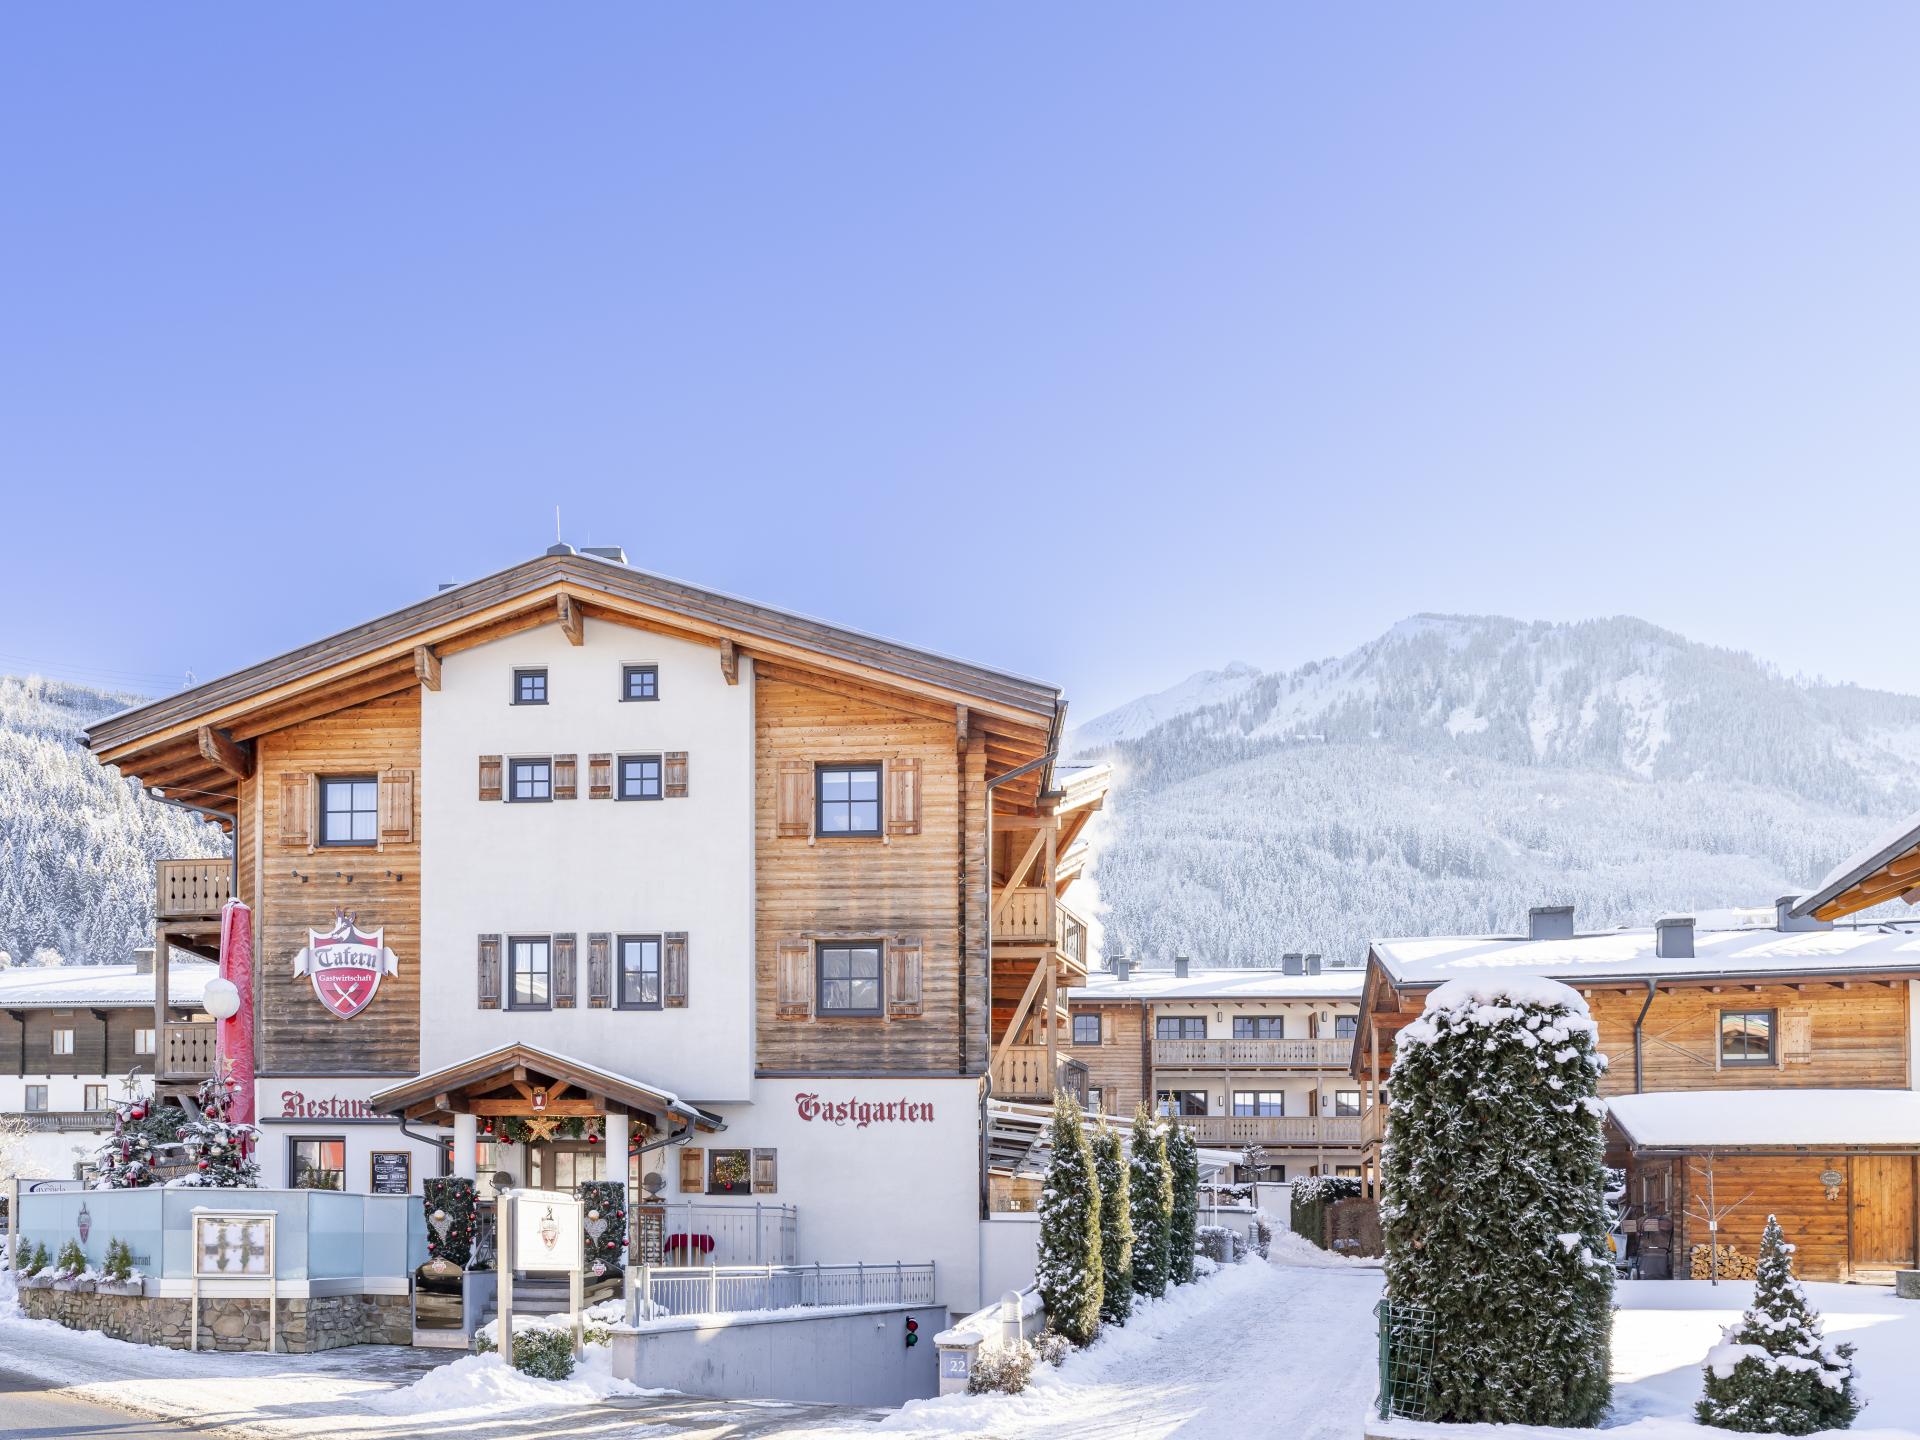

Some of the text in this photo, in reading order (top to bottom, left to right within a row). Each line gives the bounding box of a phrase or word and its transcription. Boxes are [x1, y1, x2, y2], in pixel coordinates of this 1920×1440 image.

[315, 946, 377, 968] Tafern
[319, 974, 372, 982] Gastwirtschaft
[795, 1092, 935, 1130] Gastgarten
[950, 1360, 966, 1372] 22
